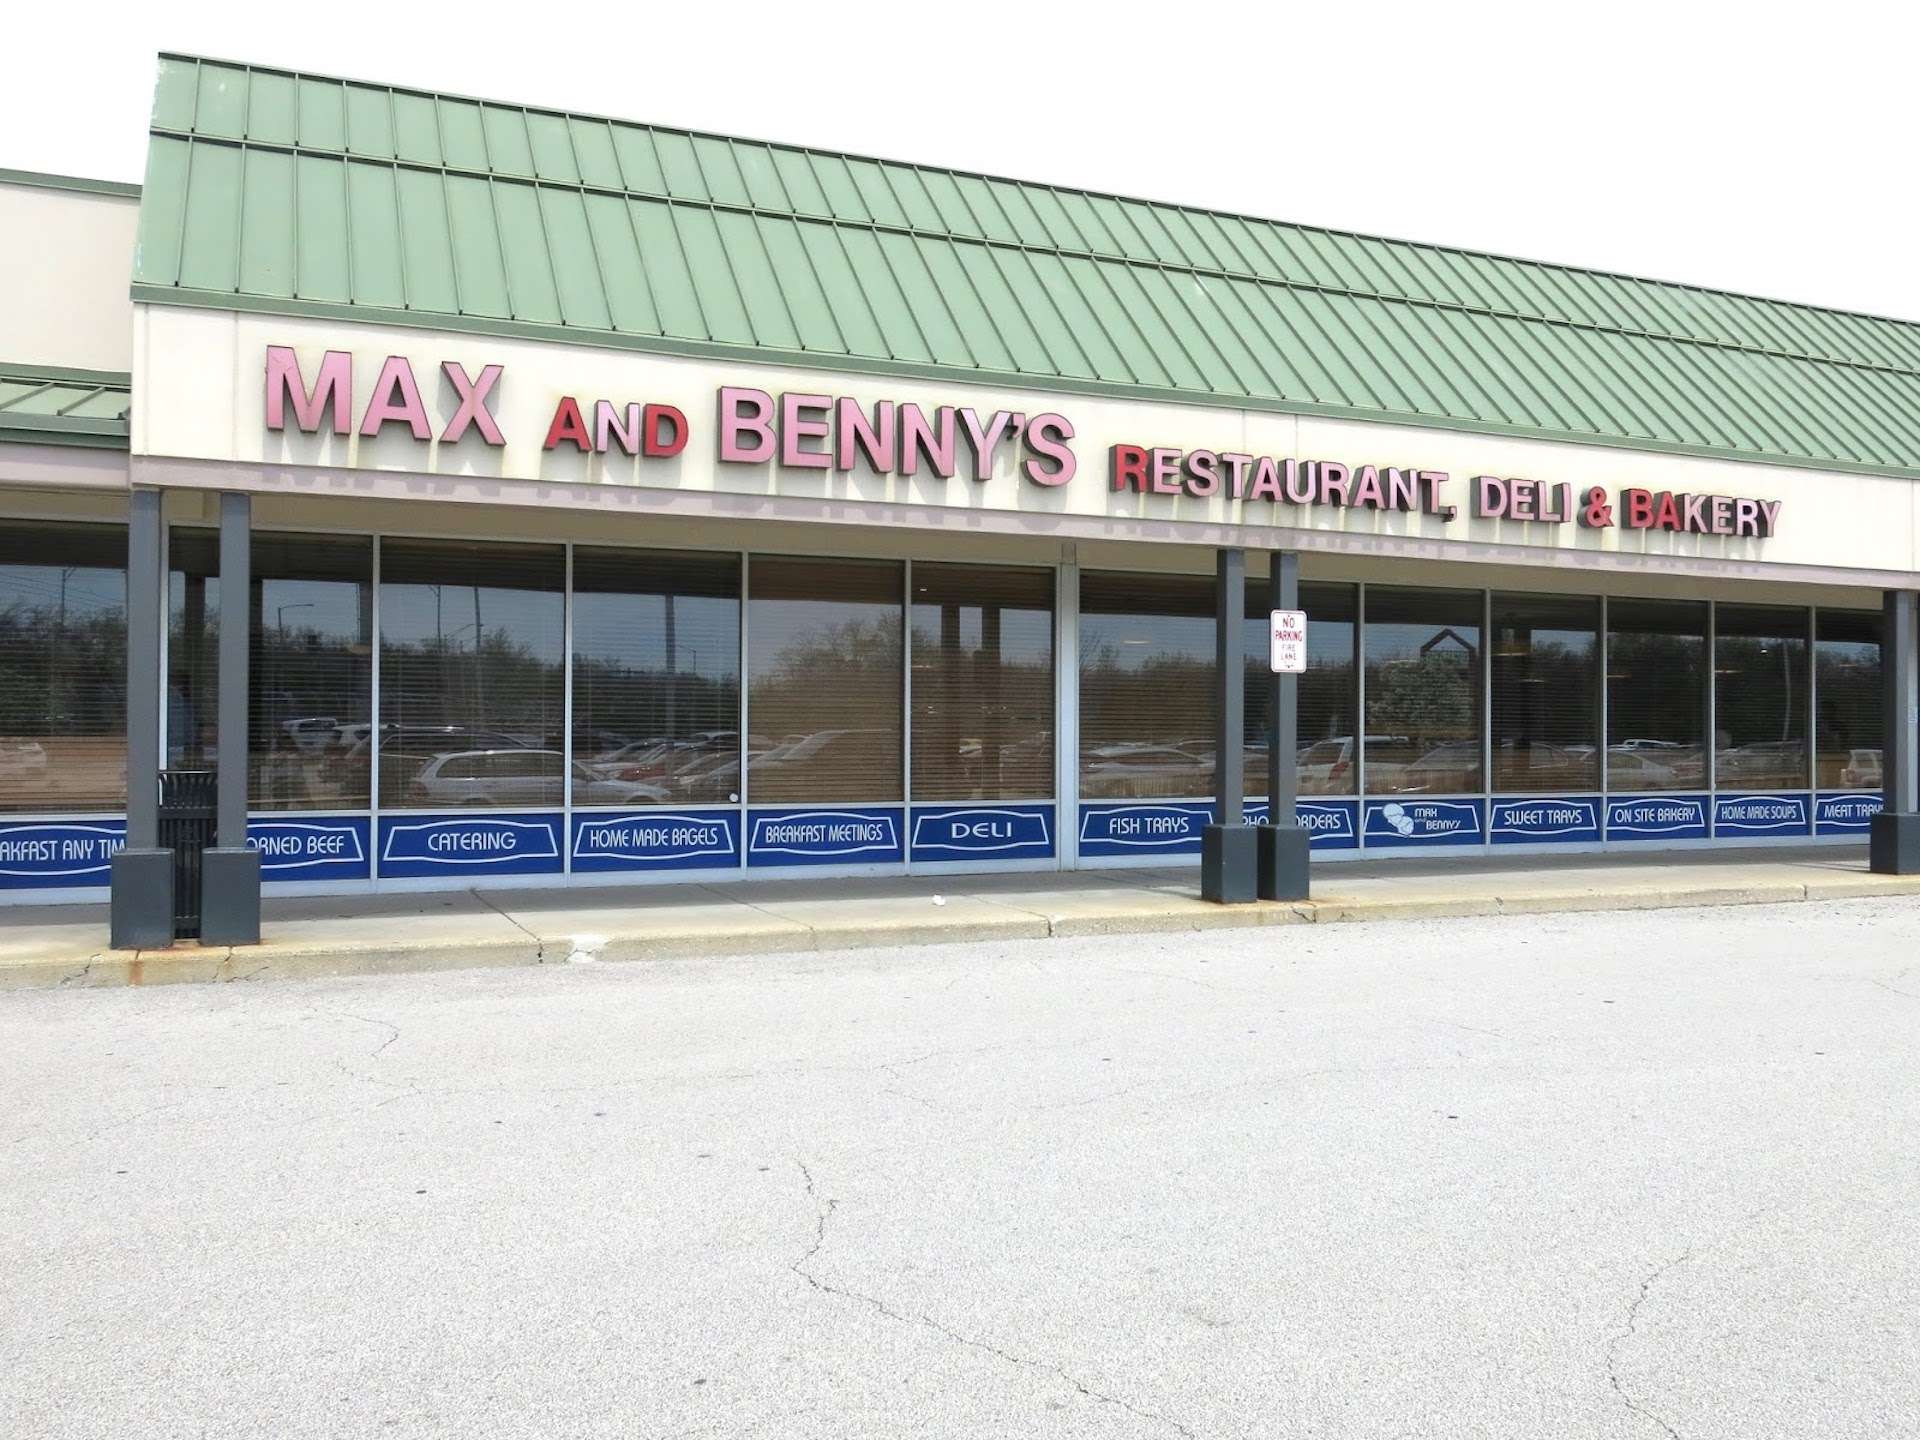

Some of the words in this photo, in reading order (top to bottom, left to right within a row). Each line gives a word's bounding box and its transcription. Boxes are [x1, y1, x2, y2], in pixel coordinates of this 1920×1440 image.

[265, 345, 507, 446] MAX
[544, 396, 689, 458] AND
[717, 385, 1078, 487] BENNY'S
[1109, 443, 1457, 523] RESTAURANT,
[1471, 475, 1573, 524] DELI
[1577, 485, 1612, 528] &
[1620, 487, 1782, 538] BAKERY
[1282, 617, 1295, 628] NO
[1275, 631, 1303, 642] PARKING
[1281, 652, 1297, 661] LANE
[1415, 808, 1437, 817] MAX
[1504, 810, 1544, 825] SWEET
[1547, 809, 1583, 824] TRAYS
[1615, 809, 1632, 823] ON
[1634, 808, 1655, 823] SITE
[1657, 807, 1695, 823] BAKERY
[1721, 806, 1745, 820] HOME
[1747, 806, 1770, 820] MADE
[1771, 806, 1797, 820] SOUPS
[1824, 804, 1853, 818] MEAT
[1855, 804, 1884, 817] TRAY
[951, 822, 1013, 839] DELI
[1109, 818, 1139, 834] FISH
[1144, 816, 1189, 834] TRAYS
[427, 831, 516, 852] CATERING
[590, 828, 629, 848] HOME
[632, 828, 668, 847] MADE
[671, 827, 718, 847] BAGELS
[765, 825, 825, 843] BREAKFAST
[828, 824, 883, 843] MEETINGS
[62, 839, 94, 860] ANY
[307, 835, 344, 854] BEEF
